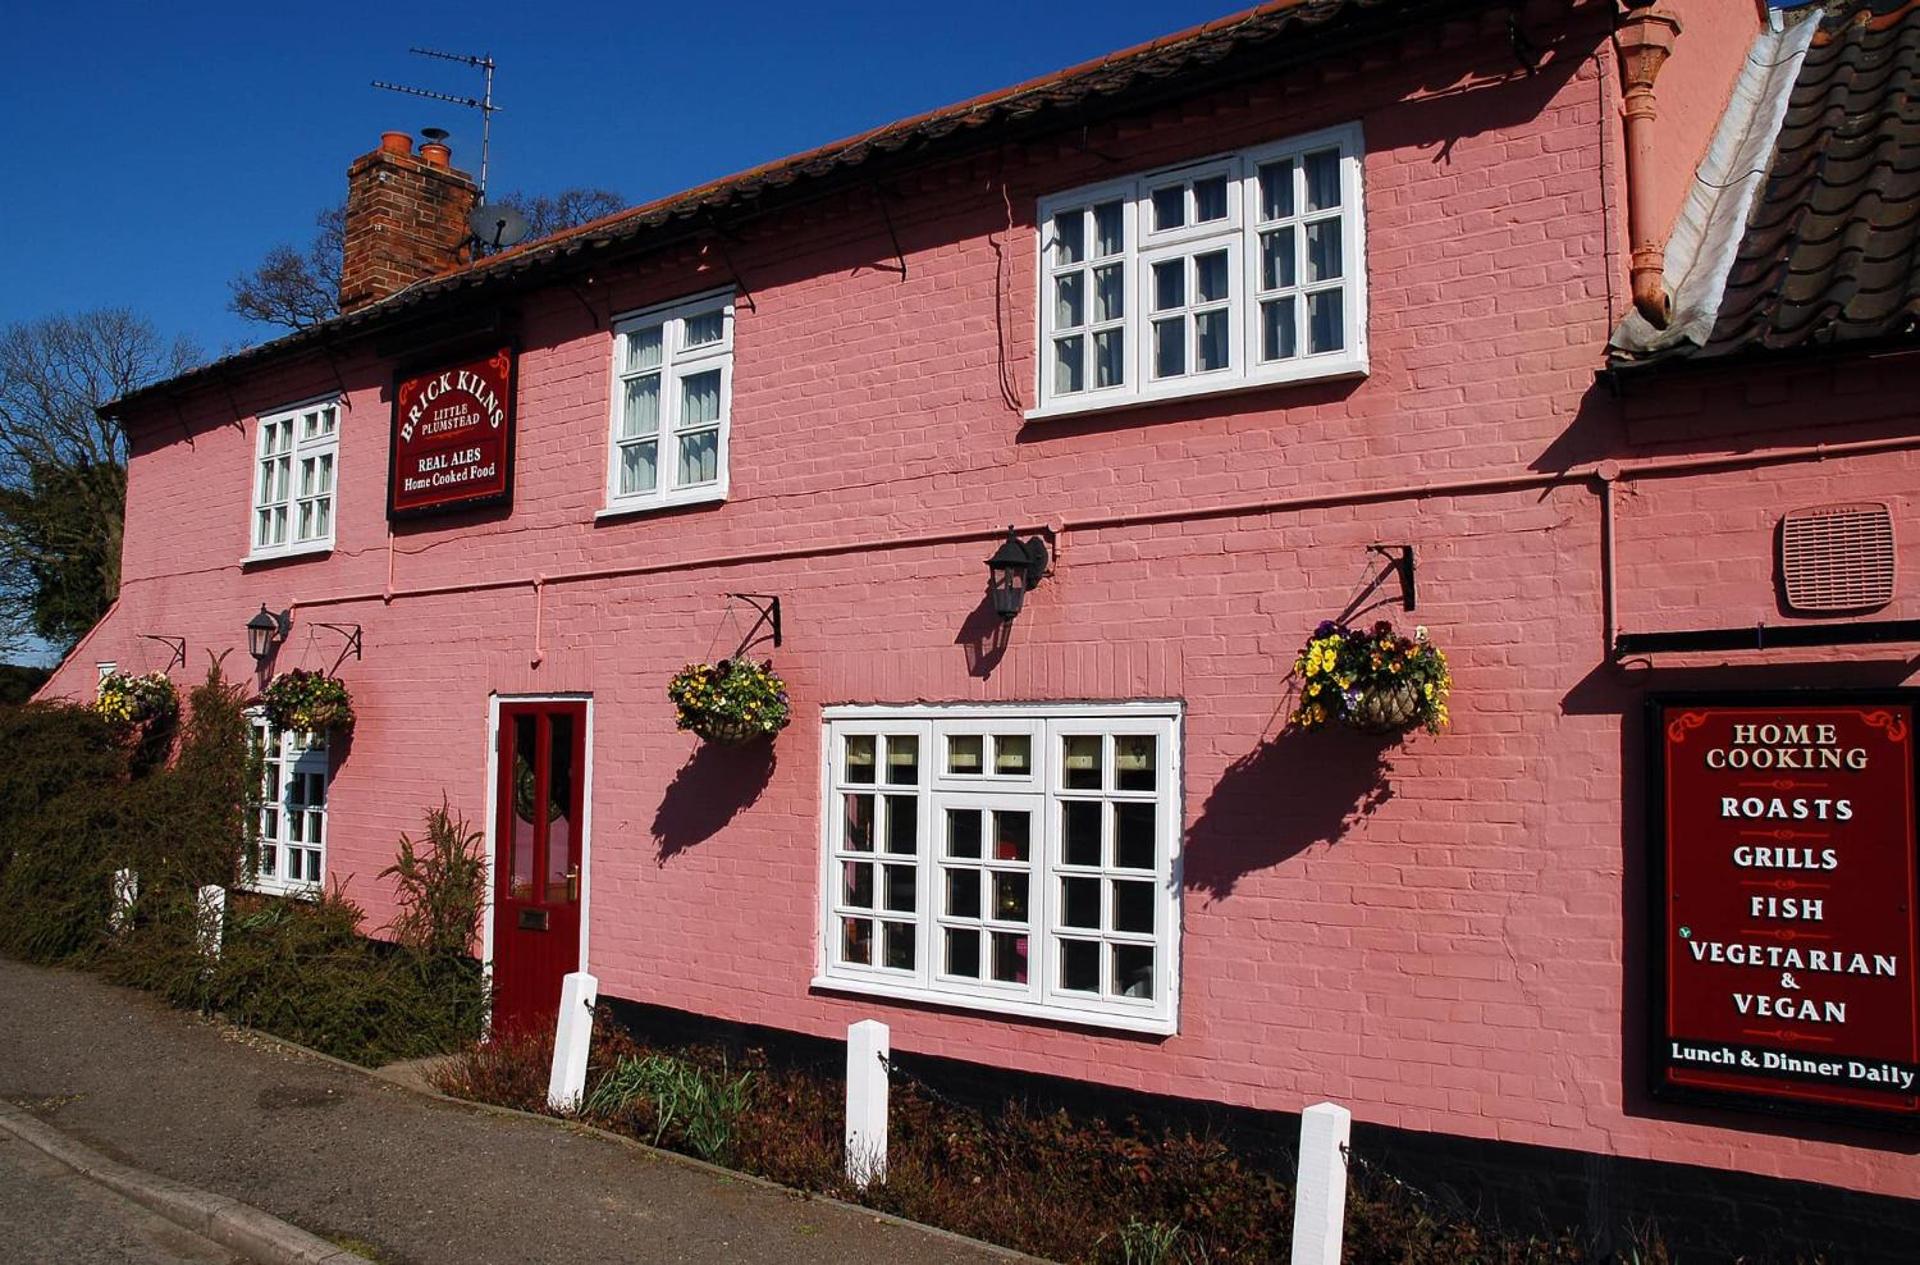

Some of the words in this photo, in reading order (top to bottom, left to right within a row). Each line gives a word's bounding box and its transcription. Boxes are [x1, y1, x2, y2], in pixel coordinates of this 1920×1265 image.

[401, 371, 452, 443] BRICK
[457, 370, 504, 429] KILNS
[434, 404, 468, 421] LITTLE
[422, 413, 480, 436] PLUMSTEAD
[418, 454, 449, 472] REAL
[451, 448, 481, 467] ALES
[405, 477, 431, 491] Home
[432, 470, 468, 487] Cooked
[470, 462, 495, 479] Food
[1734, 724, 1837, 744] HOME
[1706, 747, 1869, 769] COOKING
[1721, 798, 1853, 820] ROASTS
[1733, 847, 1839, 869] GRILLS
[1751, 897, 1824, 920] FISH
[1690, 941, 1898, 976] VEGETARIAN
[1782, 973, 1800, 989] &
[1733, 994, 1846, 1022] VEGAN
[1672, 1043, 1736, 1065] Lunch
[1740, 1052, 1760, 1067] &
[1764, 1053, 1843, 1076] Dinner
[1849, 1062, 1914, 1088] Daily
